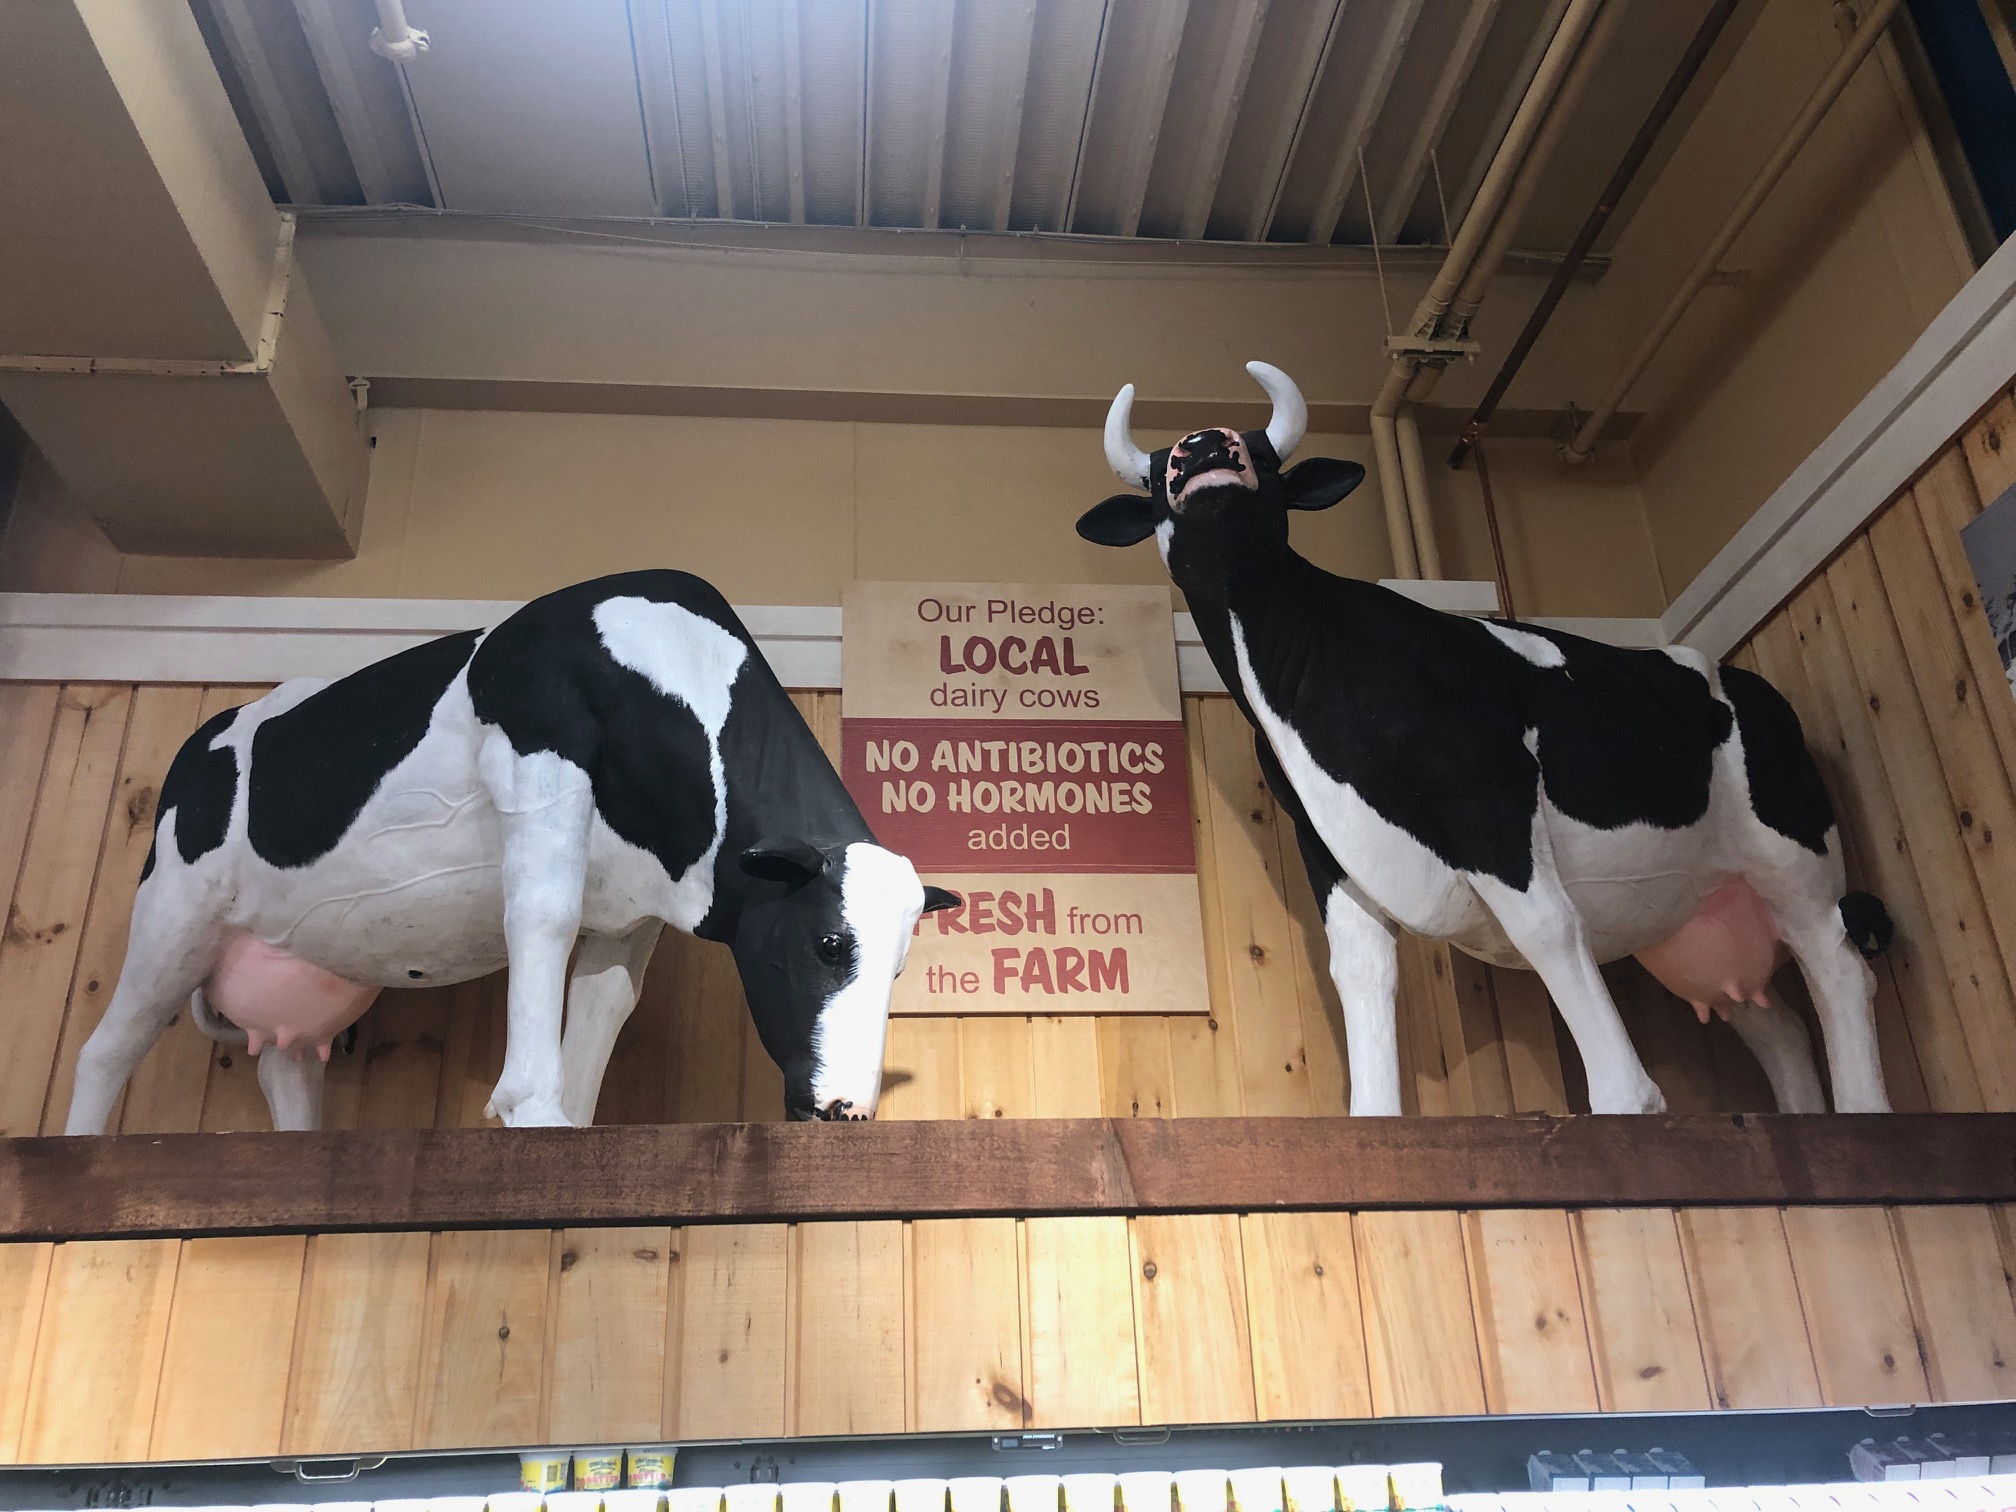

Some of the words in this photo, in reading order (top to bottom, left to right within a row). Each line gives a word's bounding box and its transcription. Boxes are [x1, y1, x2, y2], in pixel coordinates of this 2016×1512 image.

[918, 598, 977, 625] Our
[987, 598, 1105, 629] Pledge:
[941, 636, 1089, 677] LOCAL
[930, 683, 1008, 715] dairy
[1020, 689, 1100, 709] cows
[866, 741, 920, 773] NO
[932, 741, 1165, 775] ANTIBIOTICS
[882, 781, 936, 814] NO
[947, 778, 1153, 815] HORMONES
[968, 824, 1071, 850] added
[1068, 906, 1143, 935] from
[927, 965, 980, 994] the
[992, 947, 1130, 995] FARM
